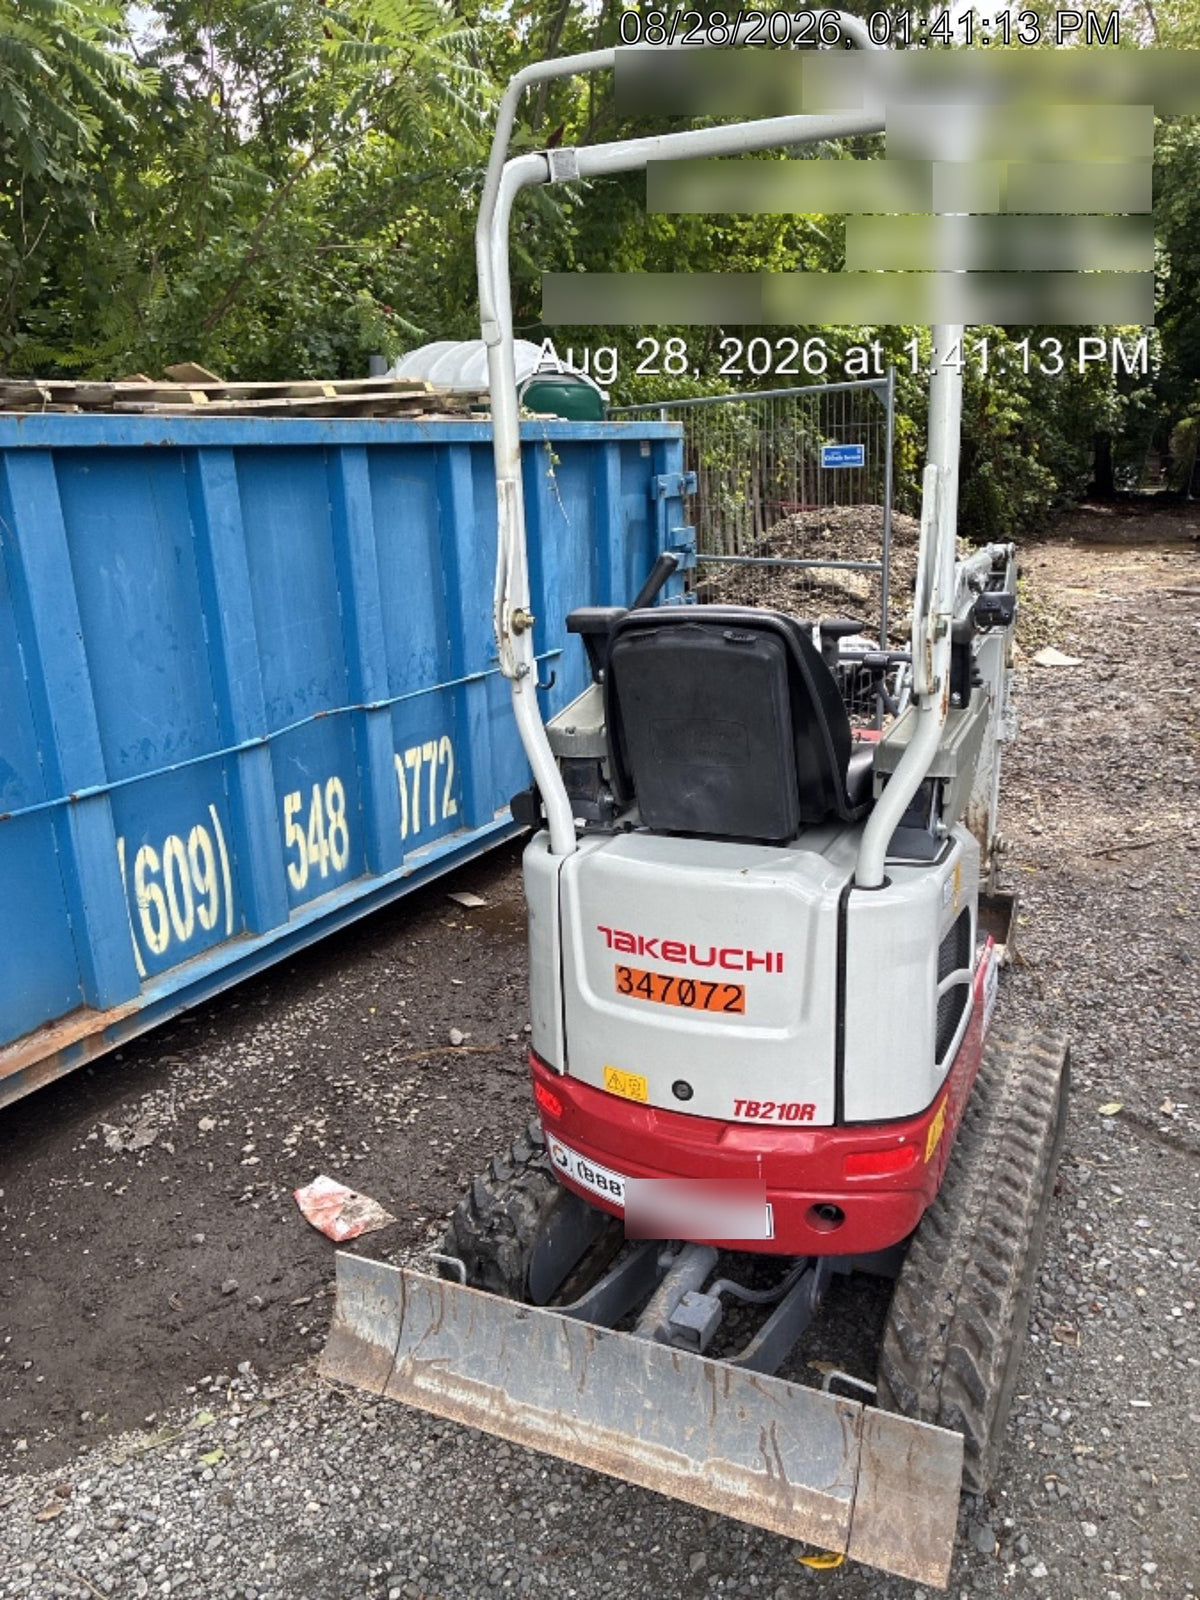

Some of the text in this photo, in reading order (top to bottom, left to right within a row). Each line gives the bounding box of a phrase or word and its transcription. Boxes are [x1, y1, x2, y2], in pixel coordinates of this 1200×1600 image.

[284, 776, 349, 890] 548
[617, 966, 742, 1013] 347072
[734, 1099, 817, 1122] TB210R
